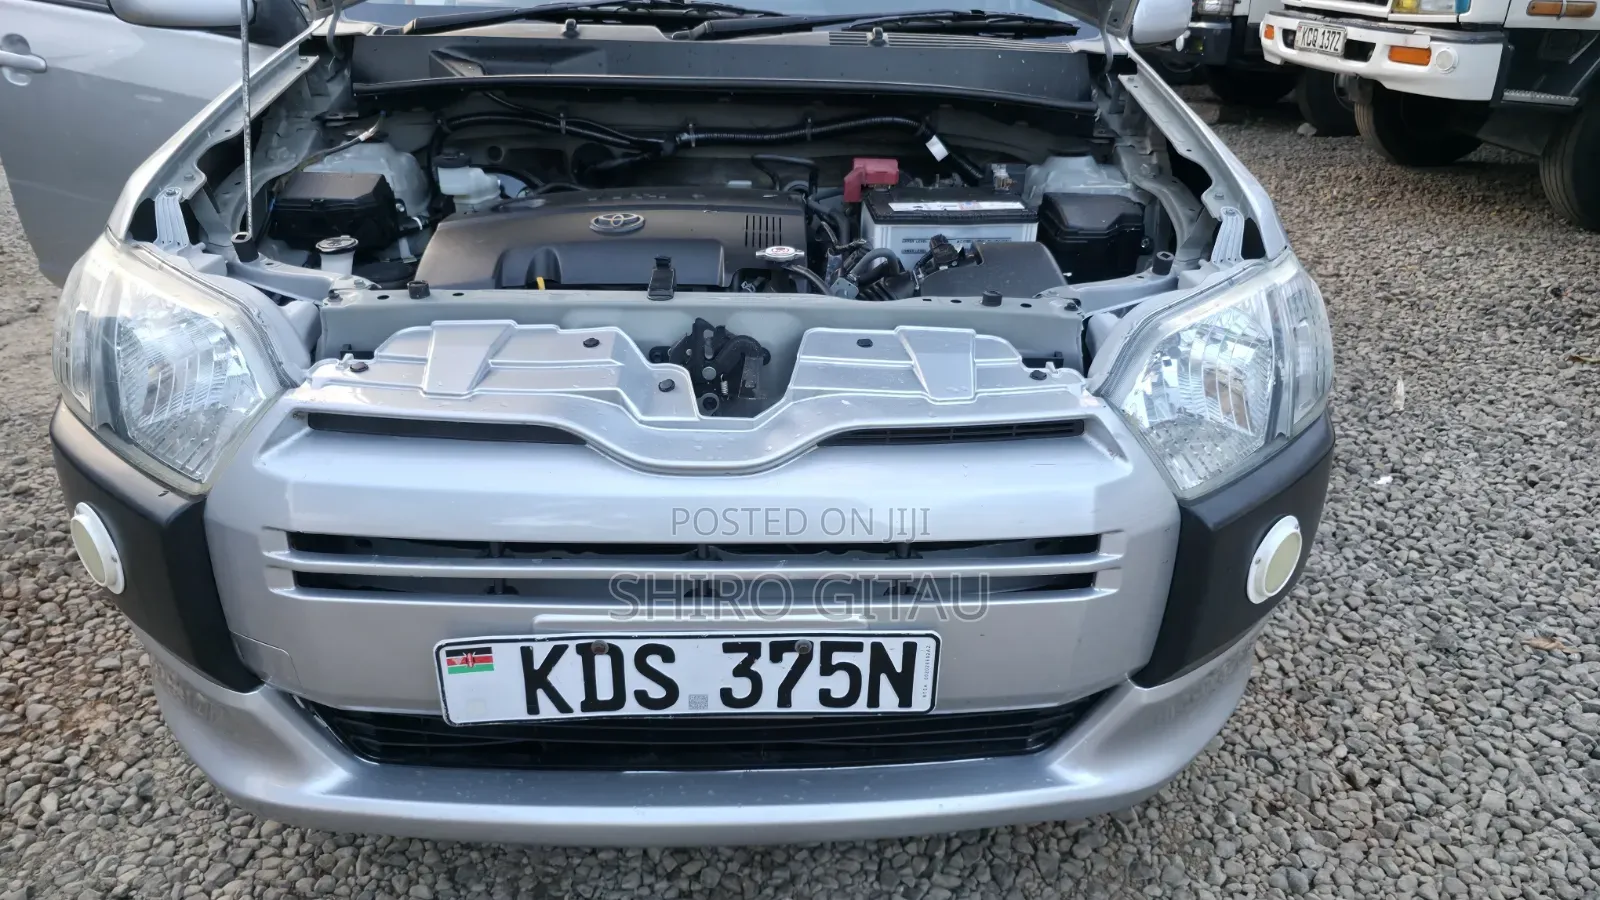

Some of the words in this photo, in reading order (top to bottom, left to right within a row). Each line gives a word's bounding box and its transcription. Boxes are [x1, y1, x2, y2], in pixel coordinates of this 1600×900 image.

[1301, 26, 1319, 48] KCQ
[519, 642, 680, 716] KDS
[719, 641, 918, 711] 375N
